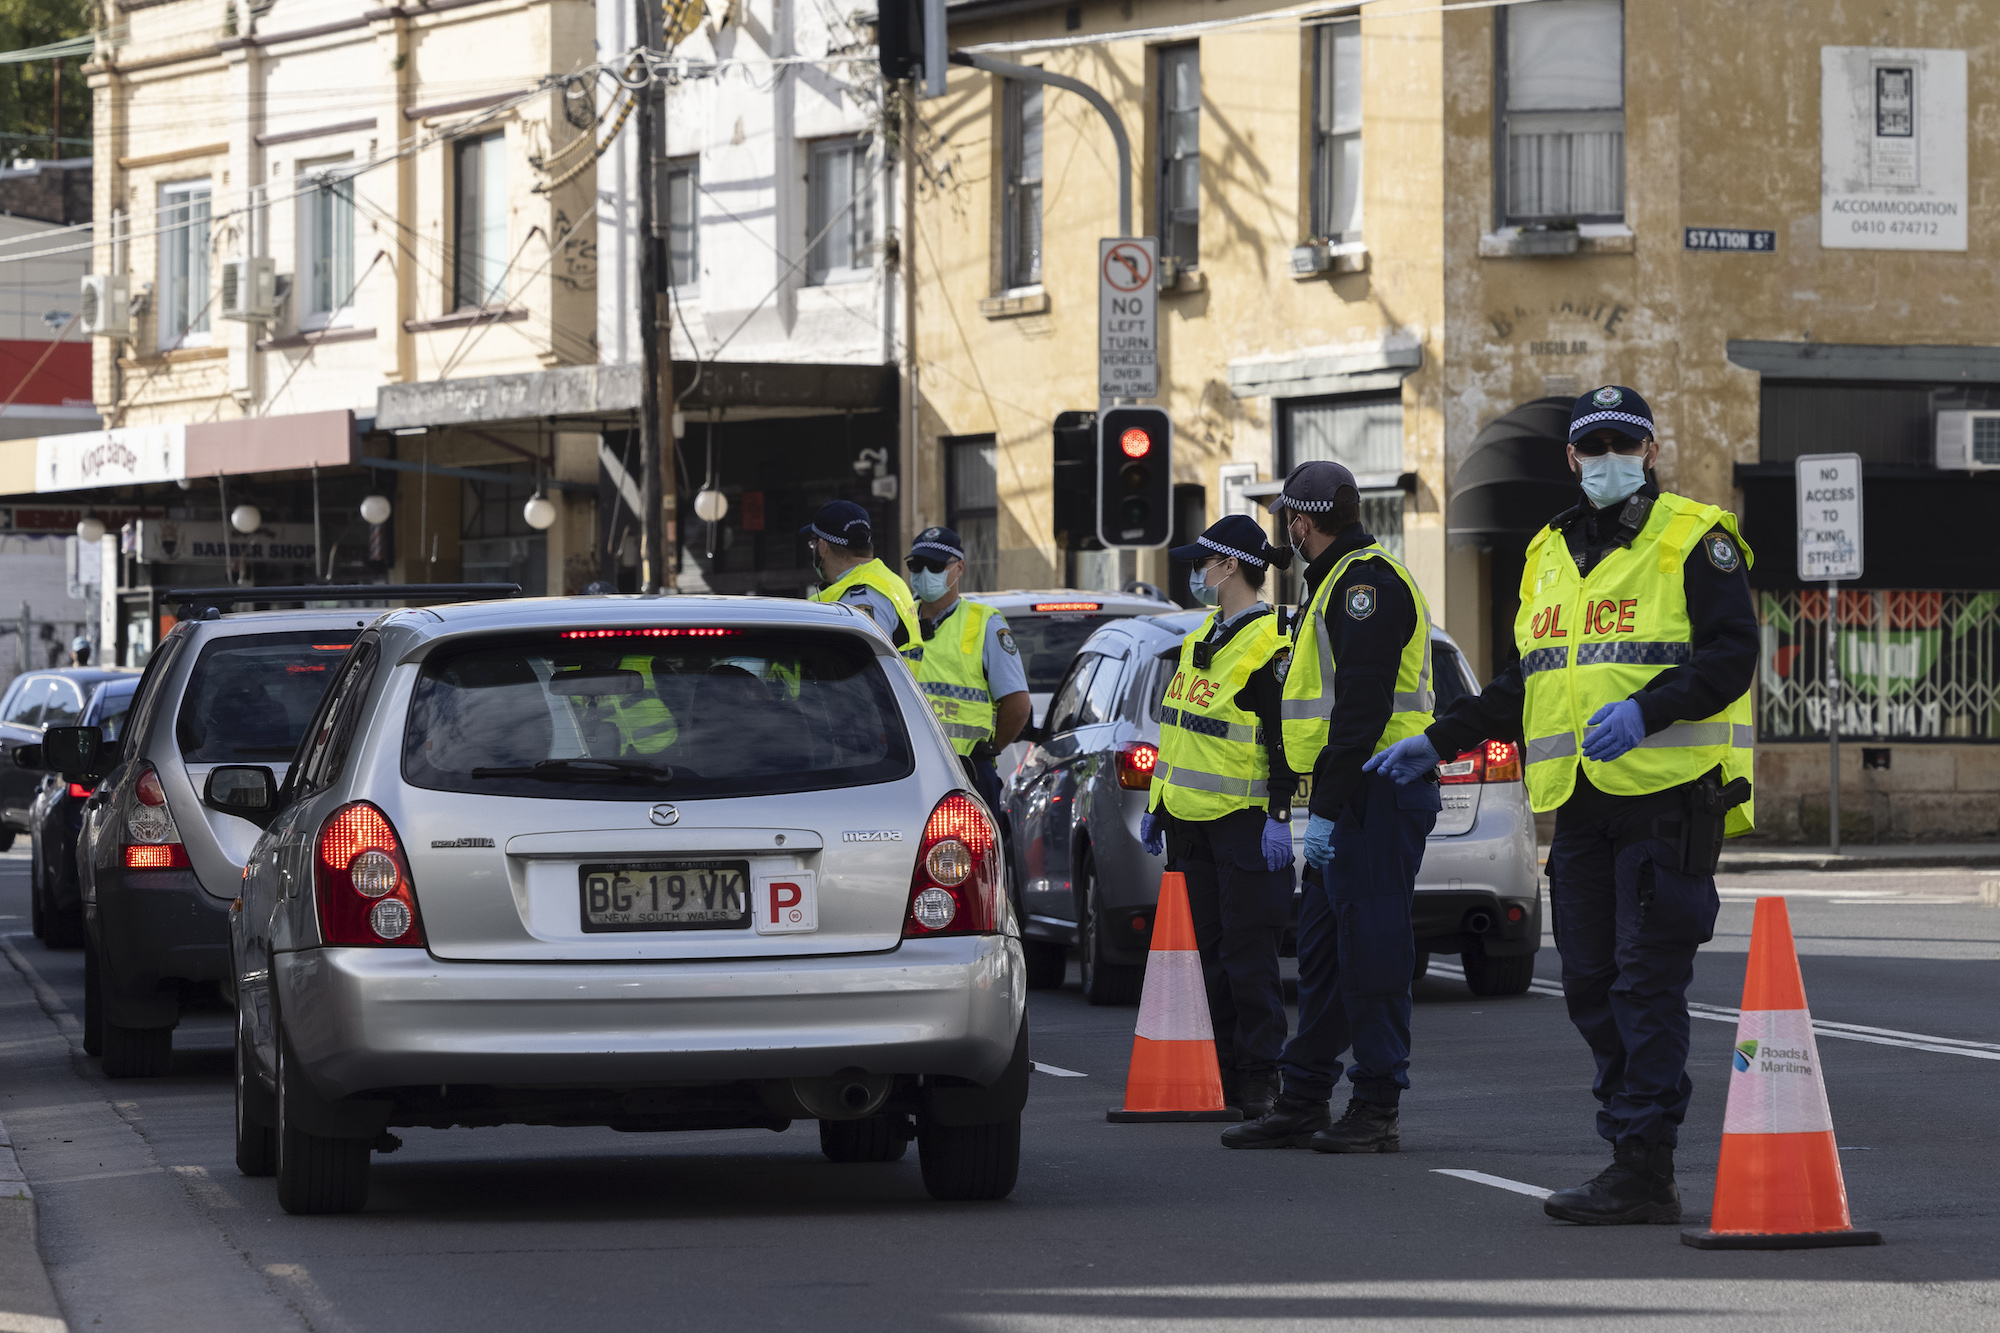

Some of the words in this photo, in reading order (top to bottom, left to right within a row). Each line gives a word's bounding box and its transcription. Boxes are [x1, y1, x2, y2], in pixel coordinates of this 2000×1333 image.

[1832, 200, 1958, 217] ACCOMMODATION
[1852, 220, 1886, 234] 0410
[1890, 221, 1938, 236] 474712
[1688, 230, 1750, 249] STATION
[1112, 298, 1143, 315] NO
[1108, 319, 1145, 333] LEFT
[1107, 336, 1149, 350] TURN
[1530, 341, 1587, 355] REGULAR
[1103, 354, 1152, 366] VEHICLES
[1113, 367, 1142, 380] OVER
[1820, 467, 1839, 480] NO
[1806, 487, 1855, 502] ACCESS
[1822, 509, 1839, 522] TO
[1816, 529, 1846, 542] KING
[192, 542, 263, 558] BARBER
[268, 543, 316, 559] SHOP
[1807, 550, 1853, 564] STREET
[770, 882, 802, 923] P
[605, 913, 631, 923] NEW
[639, 912, 679, 922] SOUTH
[688, 911, 727, 922] WALES
[1761, 1047, 1801, 1059] Roads
[1802, 1050, 1809, 1061] &
[1761, 1061, 1812, 1075] Maritime
